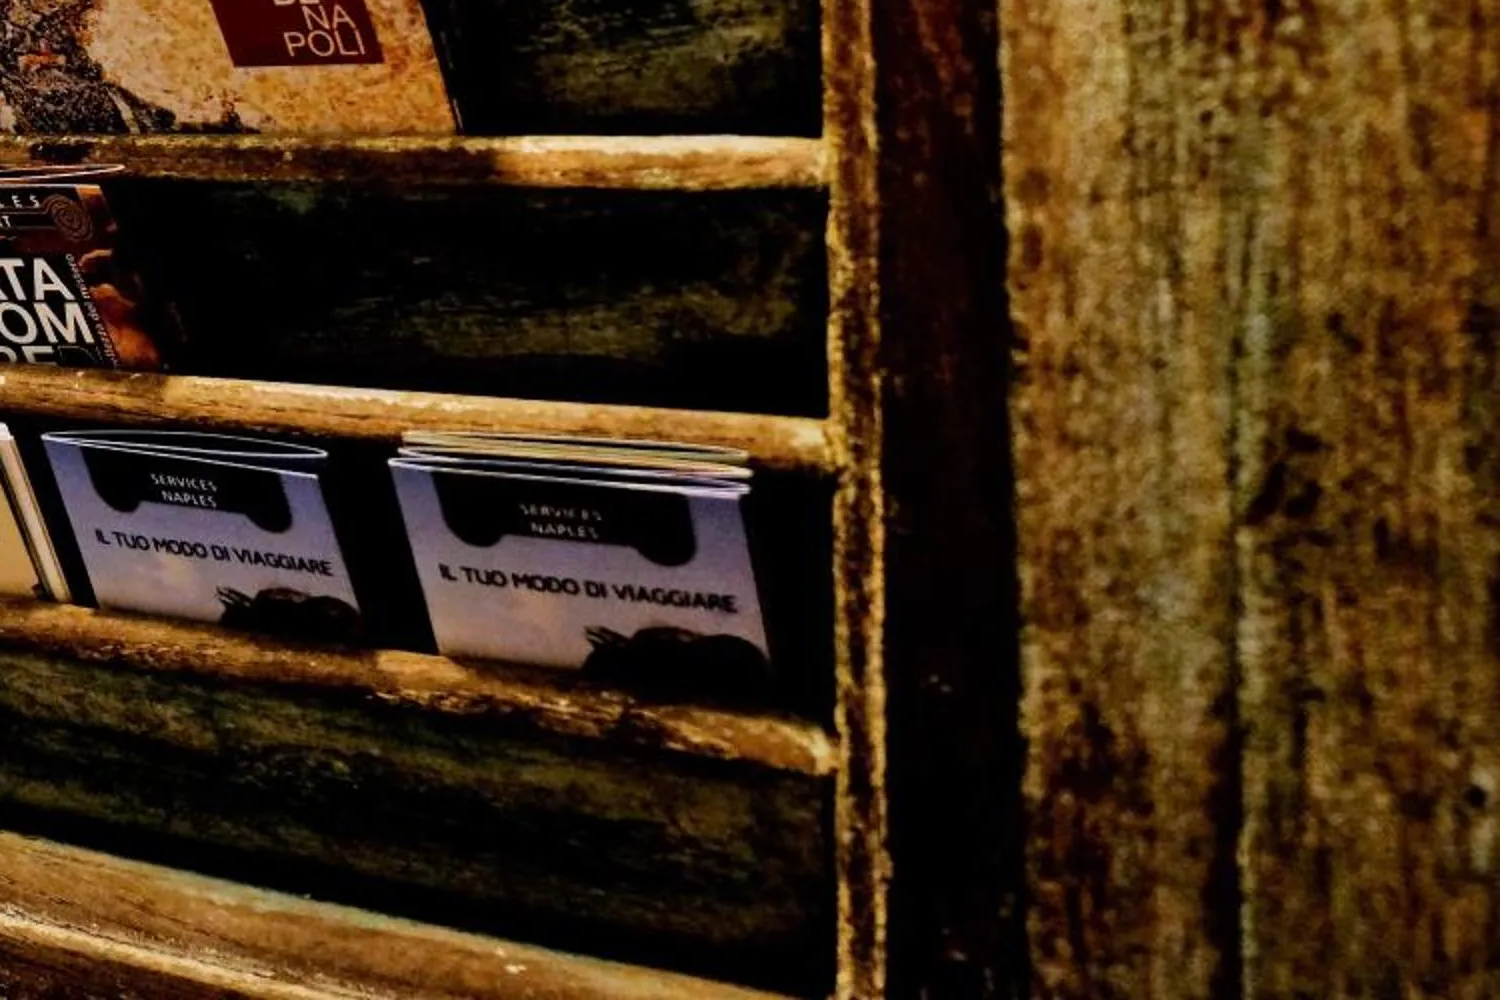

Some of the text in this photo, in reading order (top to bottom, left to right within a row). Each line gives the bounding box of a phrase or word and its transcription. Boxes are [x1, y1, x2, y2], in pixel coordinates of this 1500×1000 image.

[302, 4, 355, 30] NA
[283, 30, 365, 57] POLI
[150, 473, 218, 492] SERVICES
[162, 490, 217, 508] NAPLES
[519, 503, 603, 521] SERVICES
[530, 521, 599, 539] NAPLES
[95, 529, 334, 577] IL TUO MODO DI VIAGGIARE
[438, 564, 738, 614] IL TUO MODO DI VIAGGIARE
